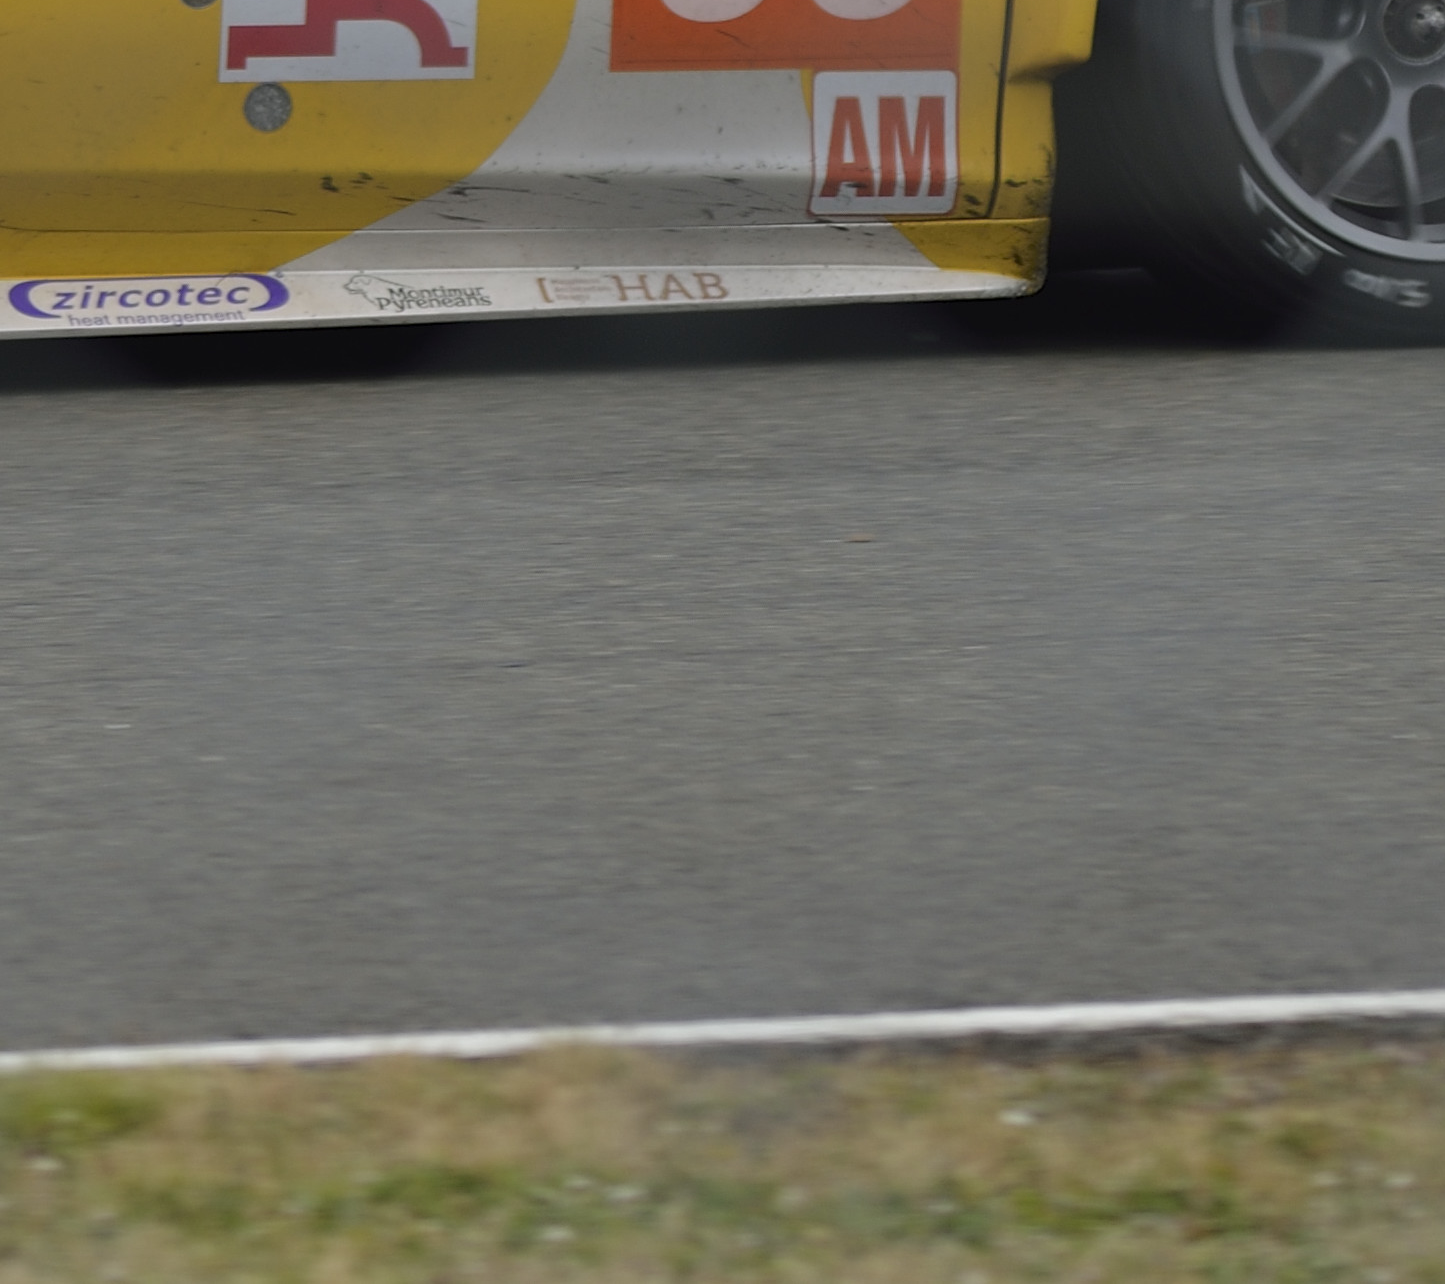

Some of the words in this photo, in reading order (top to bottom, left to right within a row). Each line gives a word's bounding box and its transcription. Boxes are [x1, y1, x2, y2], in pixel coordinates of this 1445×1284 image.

[817, 95, 946, 199] AM
[50, 284, 250, 311] zircotec
[388, 286, 485, 301] Montimur
[611, 272, 729, 301] HAB
[376, 294, 492, 313] Pyreneans
[68, 314, 111, 327] heat
[116, 310, 247, 329] management
